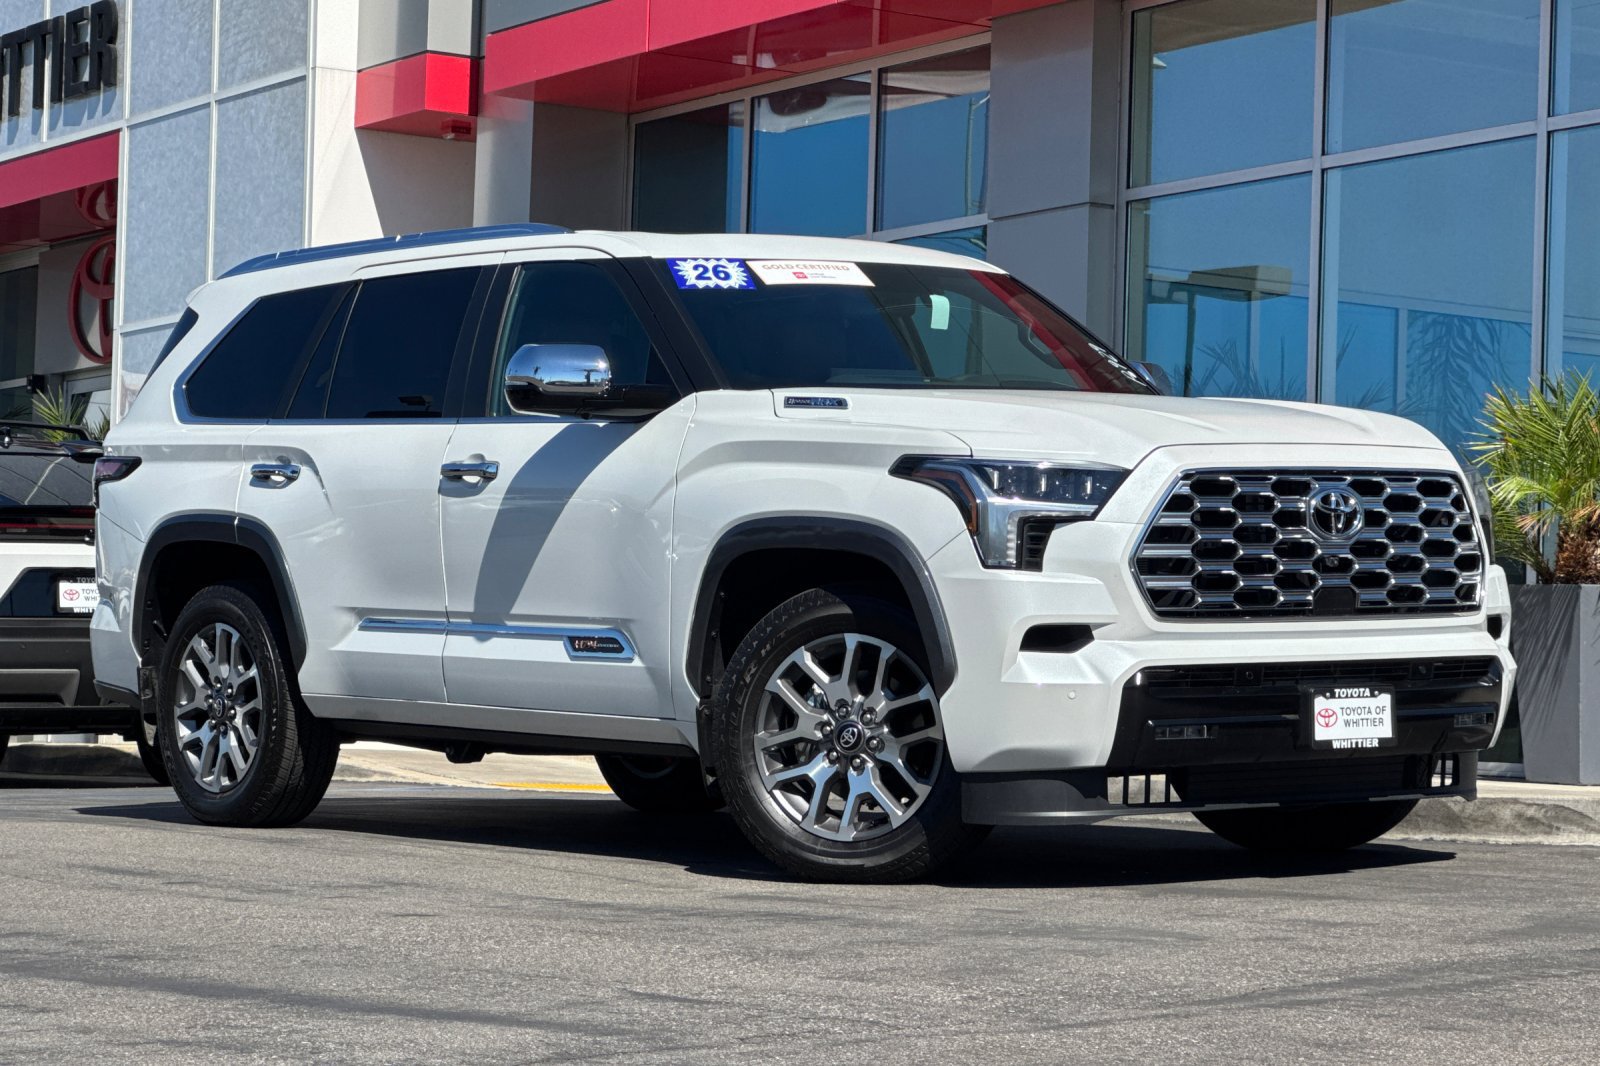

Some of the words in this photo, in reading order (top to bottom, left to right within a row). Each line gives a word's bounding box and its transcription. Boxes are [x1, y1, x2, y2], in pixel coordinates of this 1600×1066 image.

[0, 0, 118, 118] TTIER
[692, 263, 732, 281] 26
[1334, 688, 1370, 698] TOYOTA
[1340, 706, 1372, 716] TOYOTA
[1375, 706, 1387, 715] OF
[1343, 718, 1384, 727] WHITTIER
[1332, 739, 1379, 749] WHITTIER
